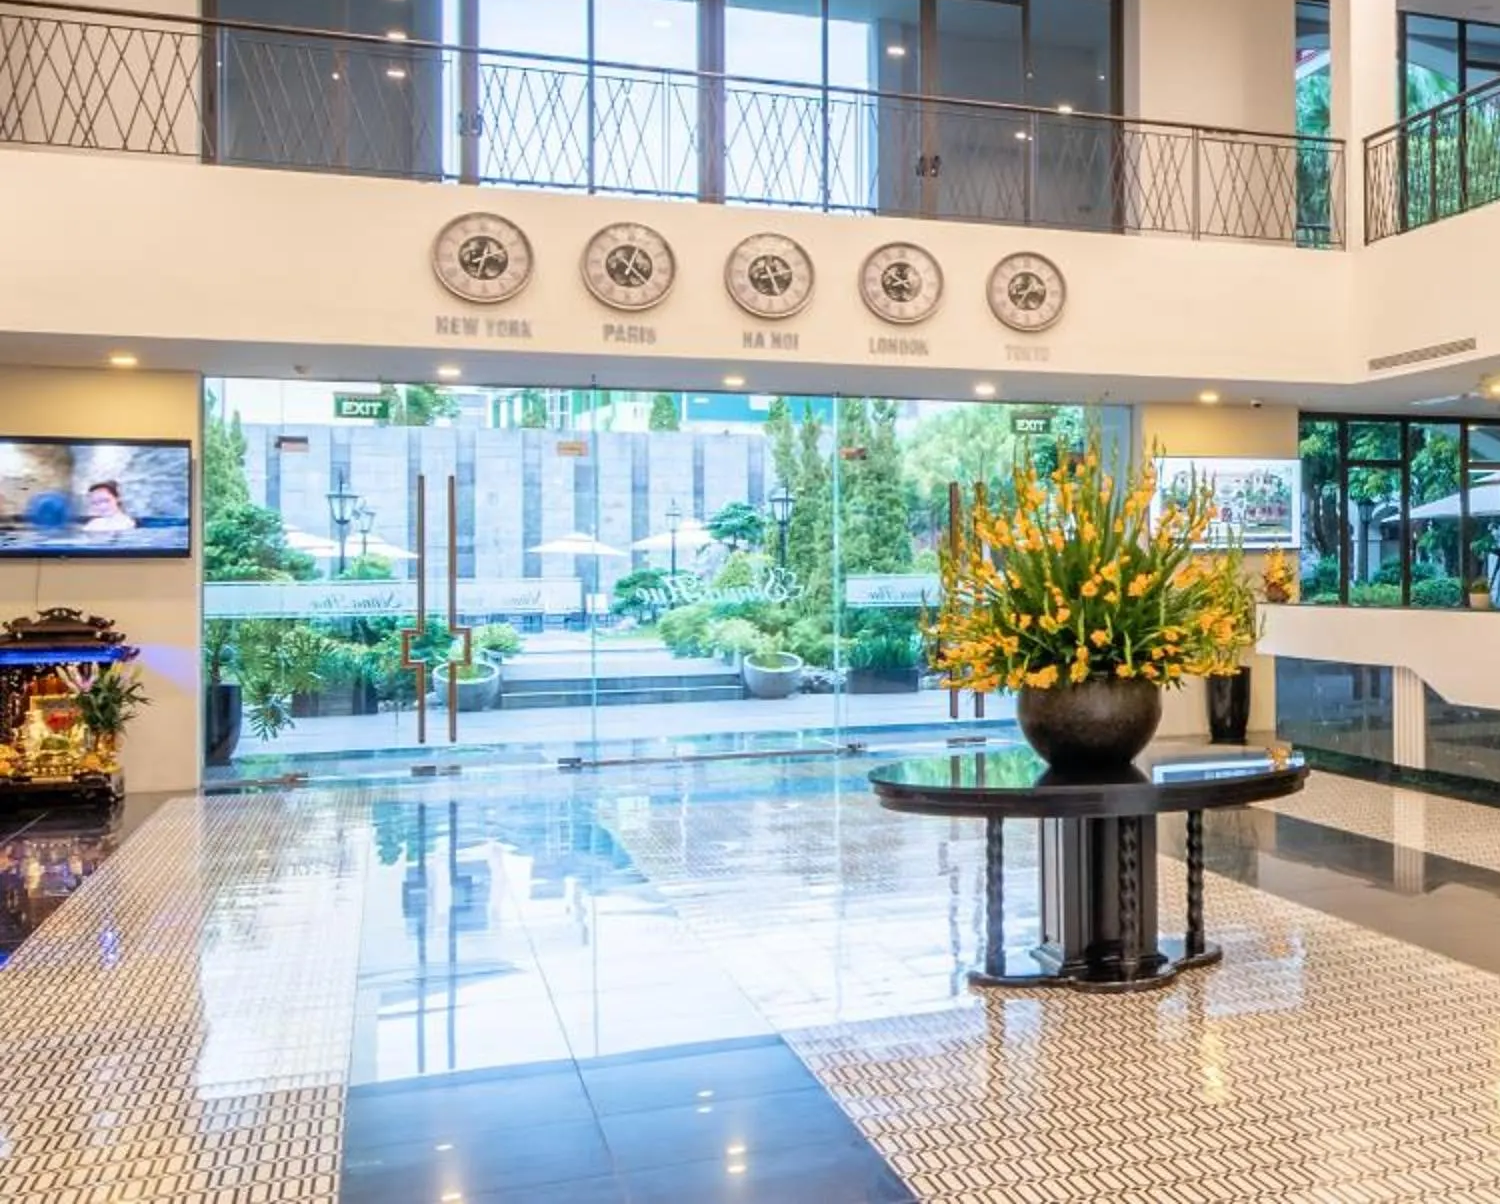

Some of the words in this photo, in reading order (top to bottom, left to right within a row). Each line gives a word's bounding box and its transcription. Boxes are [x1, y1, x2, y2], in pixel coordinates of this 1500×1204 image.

[435, 315, 479, 336] NEW
[486, 318, 533, 338] YORK
[602, 323, 656, 344] PARIS
[743, 331, 765, 349] HA
[770, 333, 799, 351] NOI
[868, 337, 929, 356] LONDON
[341, 400, 382, 415] EXIT
[1015, 418, 1046, 432] EXIT
